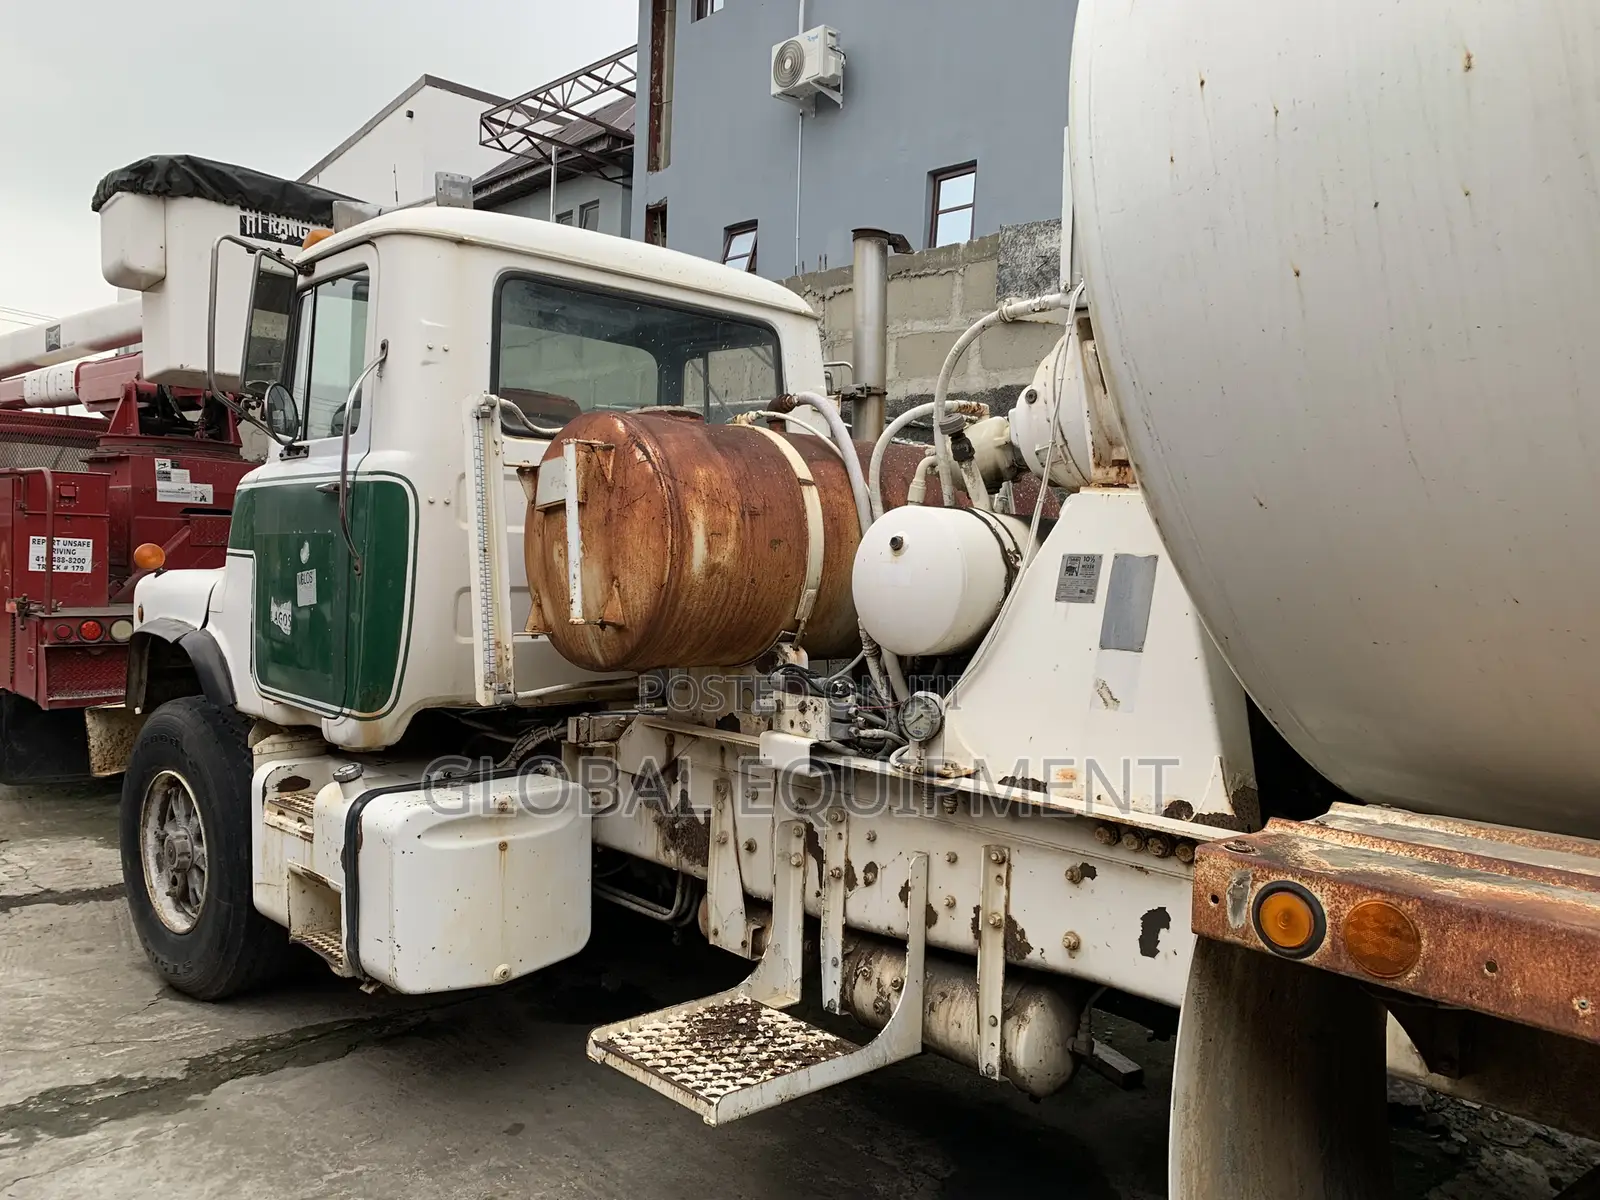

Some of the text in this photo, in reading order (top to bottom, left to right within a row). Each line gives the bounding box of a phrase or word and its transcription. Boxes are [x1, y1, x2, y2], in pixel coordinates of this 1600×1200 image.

[31, 538, 91, 548] REPRT UNSAFE
[51, 548, 77, 556] RIVING
[71, 565, 84, 573] 179
